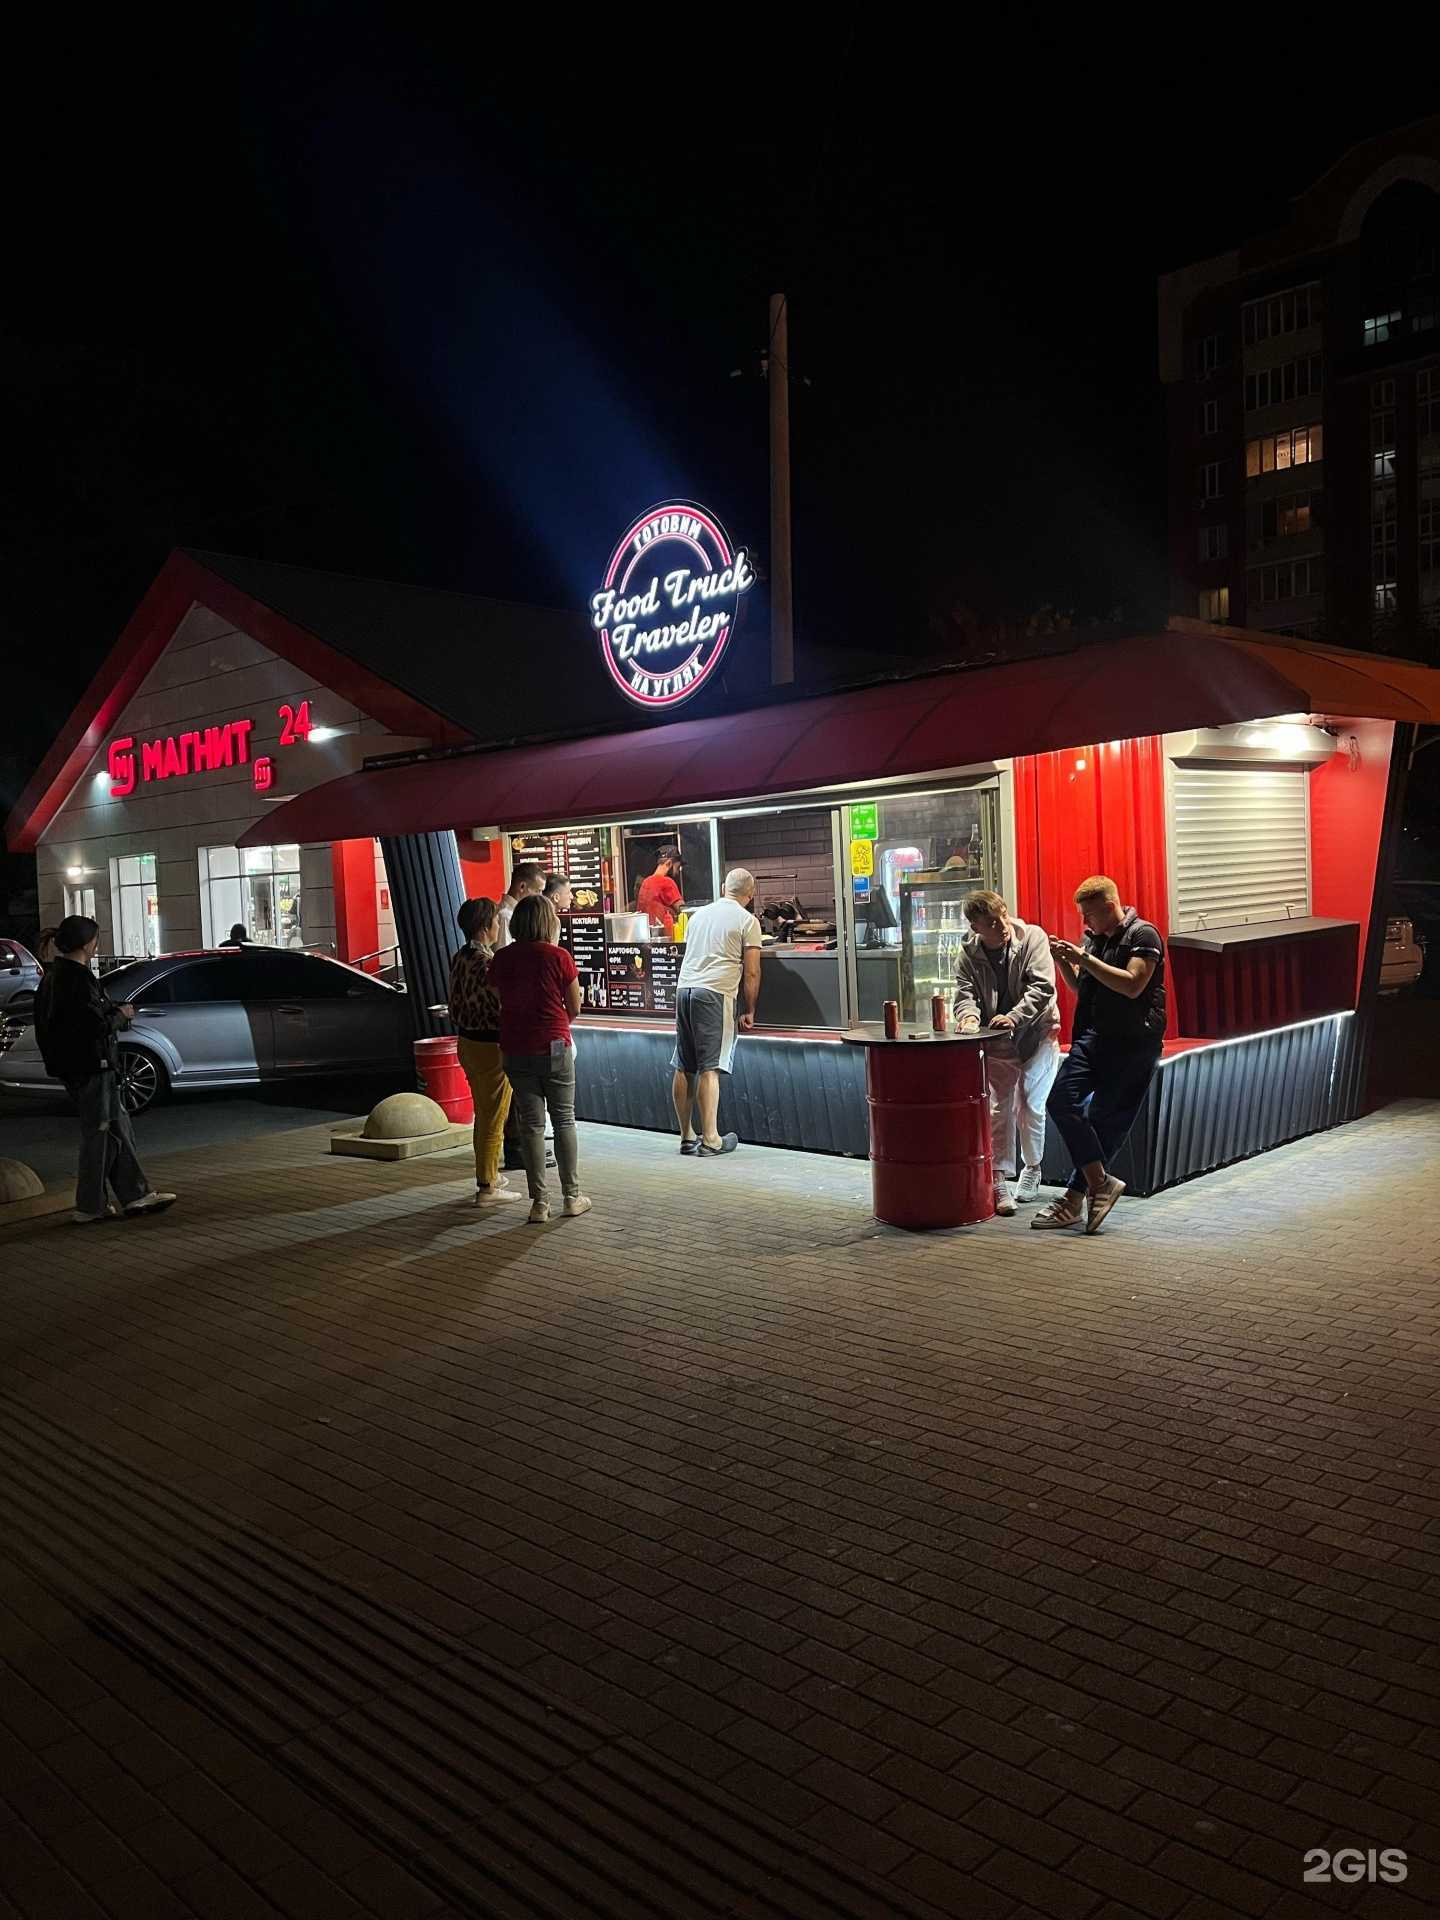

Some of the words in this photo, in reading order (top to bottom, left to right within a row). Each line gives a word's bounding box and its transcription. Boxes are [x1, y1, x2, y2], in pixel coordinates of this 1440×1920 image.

[633, 515, 702, 550] ГОТОВИМ
[592, 577, 660, 627] Food
[664, 552, 753, 607] Truck
[612, 606, 730, 659] Traveler
[630, 671, 650, 696] НА
[653, 656, 705, 697] УГЛЯХ
[278, 701, 312, 745] 24
[142, 719, 251, 781] МАГНИТ
[608, 947, 641, 955] КАРТОФЕЛЬ
[609, 956, 622, 964] ФРИ
[651, 947, 667, 955] КОФЕ
[653, 988, 666, 997] ЧАЙ
